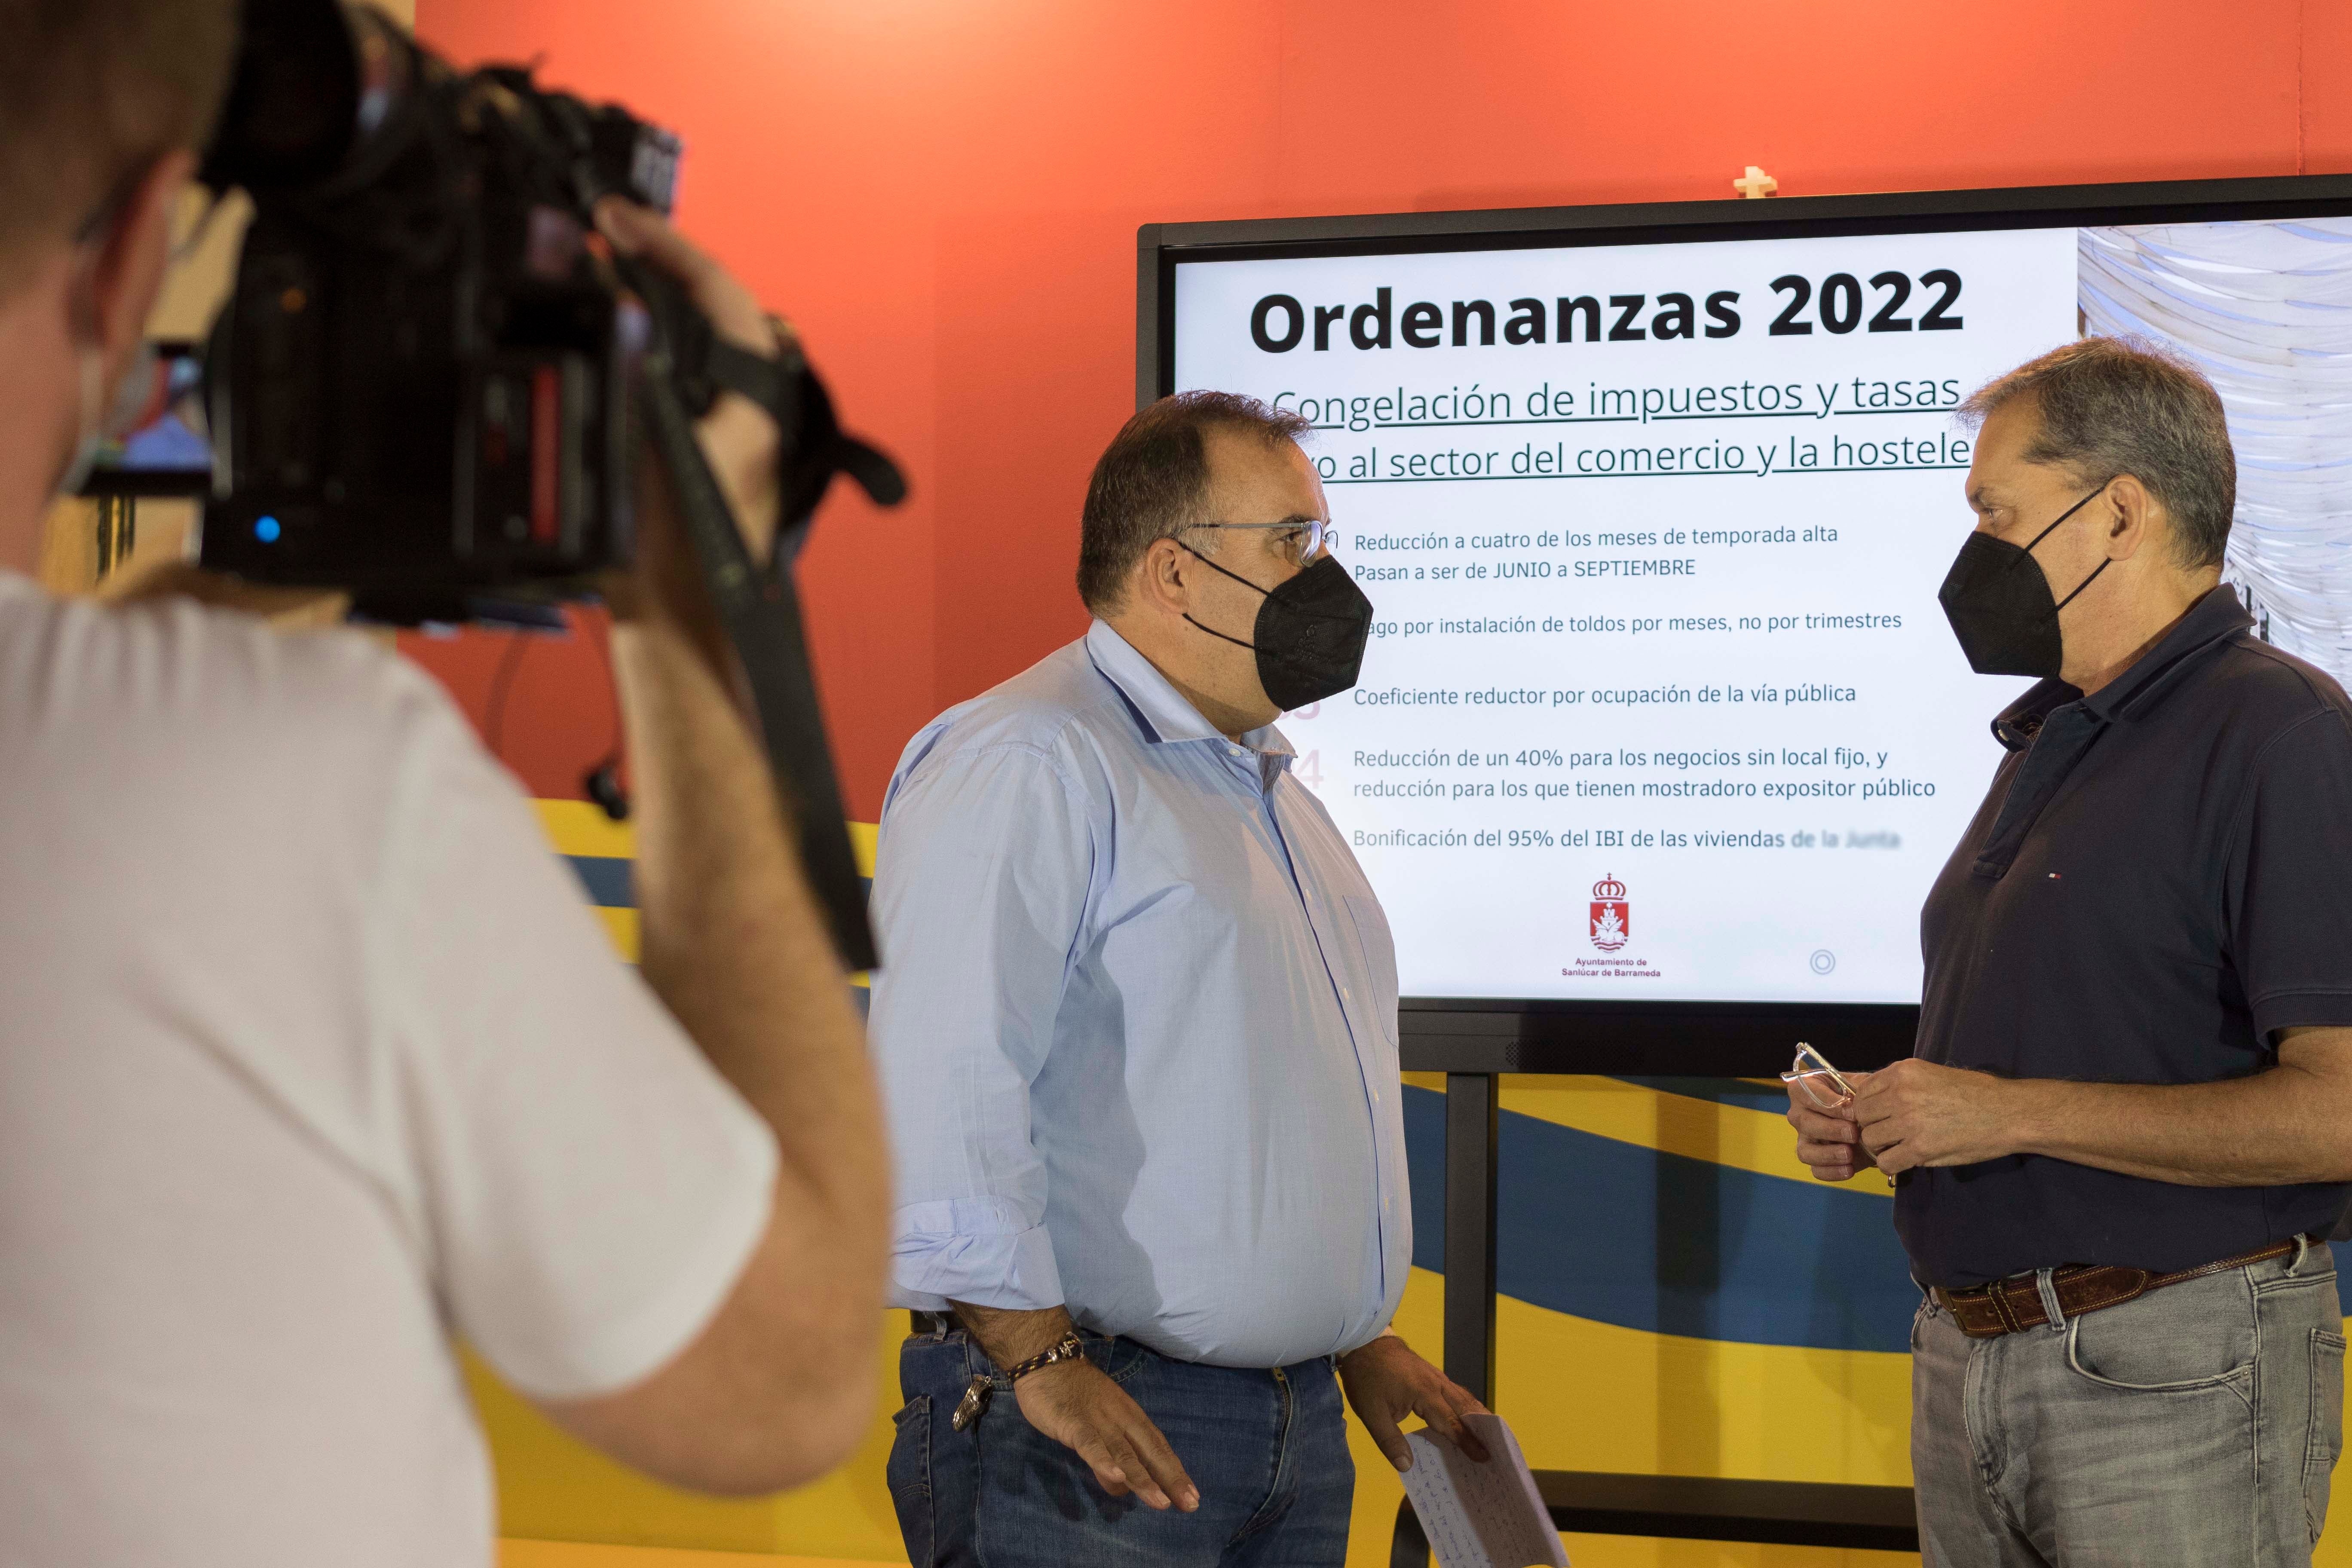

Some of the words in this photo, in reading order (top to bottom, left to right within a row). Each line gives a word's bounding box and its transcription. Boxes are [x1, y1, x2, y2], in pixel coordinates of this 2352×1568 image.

[1250, 286, 1742, 353] Ordenanzas
[1768, 268, 1964, 335] 2022
[1527, 382, 1574, 416] de
[1590, 380, 1803, 423] impuestos
[1816, 383, 1839, 418] y
[1851, 377, 1960, 407] tasas
[1350, 447, 1376, 478] al
[1390, 448, 1499, 477] sector
[1511, 443, 1562, 474] del
[1577, 439, 1744, 472] comercio
[1757, 444, 1777, 477] y
[1791, 436, 1819, 468] la
[1355, 532, 1448, 551] Reducción
[1455, 536, 1464, 549] a
[1471, 533, 1530, 548] cuatro
[1537, 530, 1559, 547] de
[1566, 530, 1591, 547] los
[1599, 533, 1657, 546] meses
[1664, 527, 1686, 545] de
[1692, 526, 1795, 547] temporada
[1803, 525, 1838, 542] alta
[1355, 565, 1408, 580] Pasan
[1415, 567, 1424, 580] a
[1431, 567, 1459, 579] ser
[1465, 562, 1487, 579] de
[1493, 561, 1551, 579] JUNIO
[1557, 565, 1567, 577] a
[1574, 559, 1696, 577] SEPTIEMBRE
[1368, 622, 1398, 638] ago
[1404, 622, 1434, 638] por
[1440, 616, 1535, 634] instalación
[1542, 616, 1564, 632] de
[1569, 615, 1626, 632] toldos
[1632, 619, 1663, 635] por
[1669, 618, 1732, 632] meses,
[1740, 617, 1761, 630] no
[1768, 617, 1799, 633] por
[1805, 612, 1902, 629] trimestres
[1354, 688, 1458, 705] Coeficiente
[1465, 687, 1547, 704] reductor
[1553, 690, 1585, 707] por
[1592, 684, 1690, 707] ocupación
[1698, 685, 1721, 703] de
[1728, 685, 1743, 702] la
[1751, 683, 1777, 702] vía
[1785, 683, 1856, 706] pública
[1293, 749, 1324, 789] 4
[1354, 748, 1450, 766] Reducción
[1457, 749, 1479, 766] de
[1486, 753, 1508, 766] un
[1515, 749, 1563, 766] 40%
[1570, 753, 1612, 770] para
[1620, 748, 1647, 766] los
[1654, 749, 1740, 770] negocios
[1748, 748, 1775, 766] sin
[1782, 747, 1827, 766] local
[1834, 747, 1870, 769] fijo,
[1876, 752, 1888, 769] y
[1354, 778, 1445, 797] reducción
[1453, 784, 1494, 801] para
[1502, 779, 1528, 797] los
[1535, 784, 1569, 801] que
[1575, 780, 1635, 796] tienen
[1643, 779, 1756, 797] mostradoro
[1763, 779, 1856, 800] expositor
[1863, 777, 1936, 800] público
[1354, 828, 1467, 846] Bonificación
[1474, 829, 1501, 846] del
[1508, 830, 1554, 847] 95%
[1561, 829, 1588, 847] del
[1596, 830, 1624, 846] IBI
[1631, 829, 1654, 847] de
[1661, 829, 1687, 847] las
[1694, 830, 1785, 848] viviendas
[1562, 968, 1599, 977] Sanlúcar
[1602, 968, 1612, 977] de
[1614, 969, 1661, 977] Barrameda
[1575, 958, 1634, 967] Ayuntamiento
